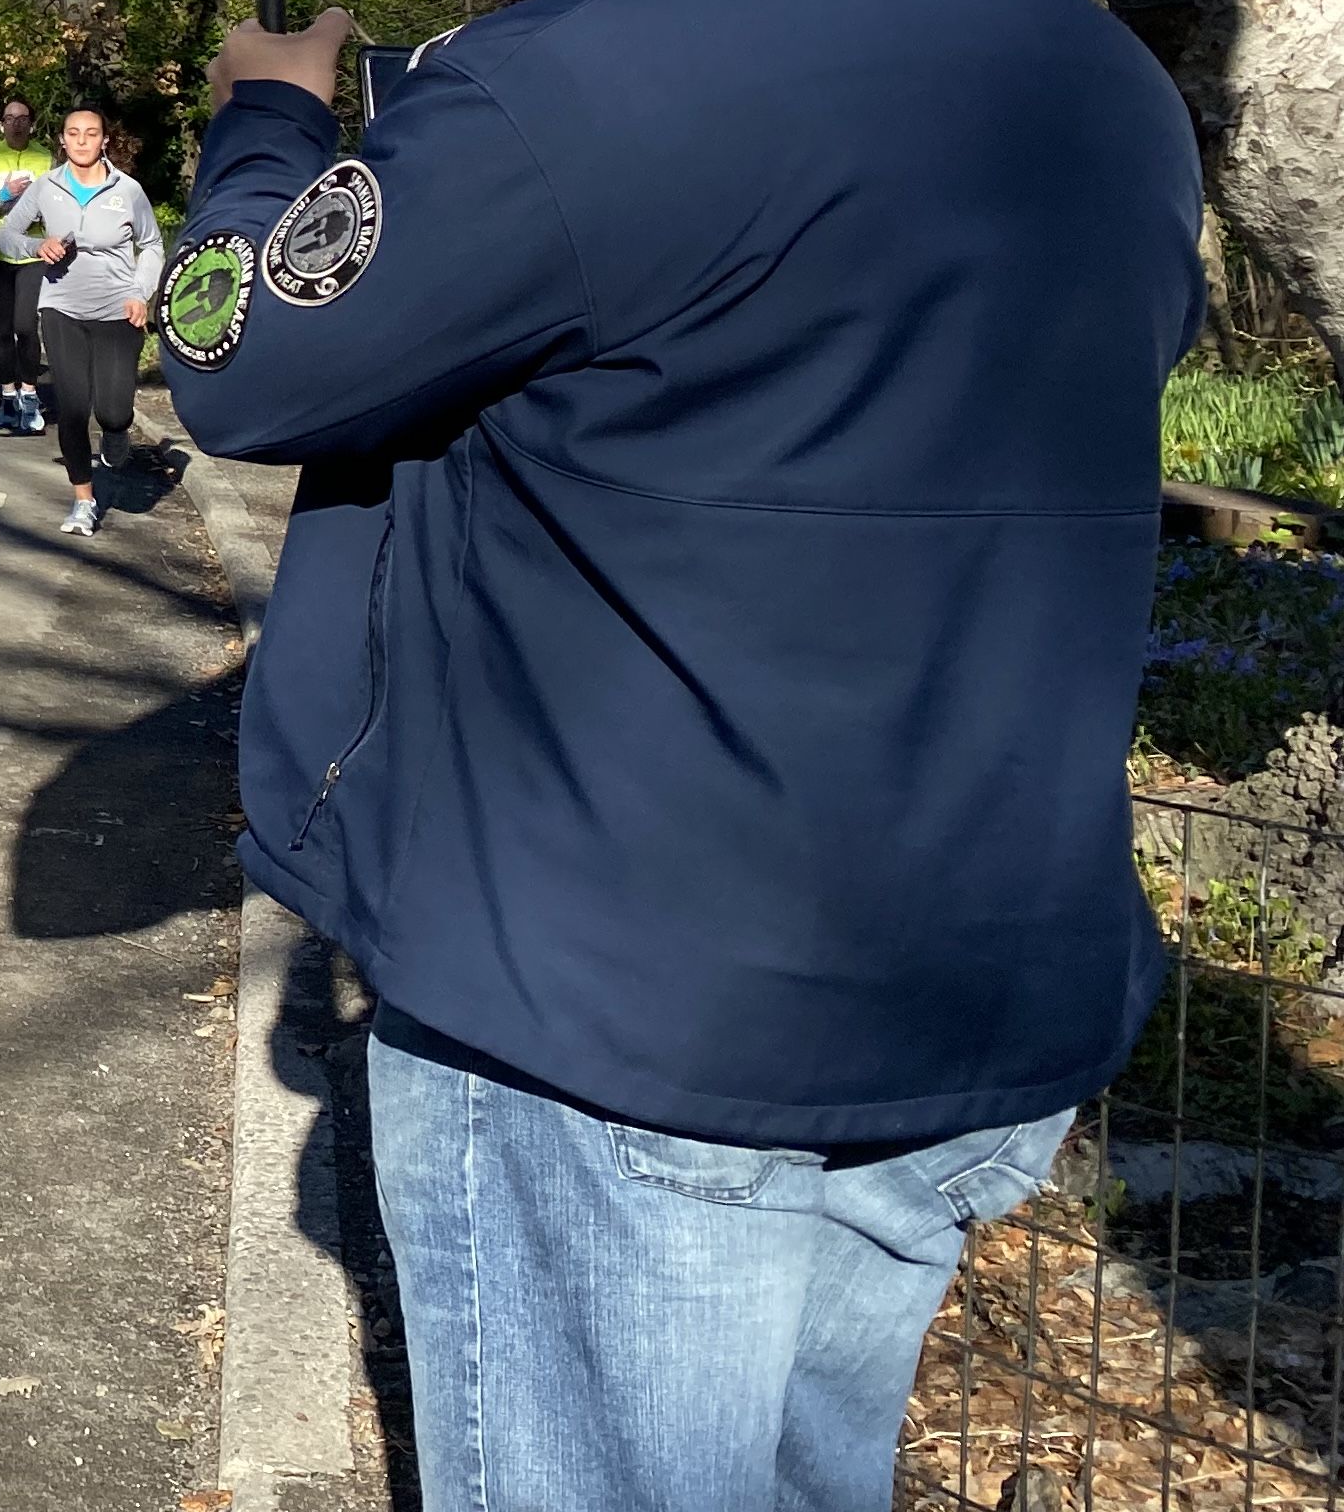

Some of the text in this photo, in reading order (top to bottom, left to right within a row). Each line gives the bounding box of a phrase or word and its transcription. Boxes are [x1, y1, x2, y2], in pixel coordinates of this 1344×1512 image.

[348, 172, 376, 267] SPARTAN RACE
[225, 235, 255, 346] SPARTAN BEAST
[273, 268, 306, 294] HEAT
